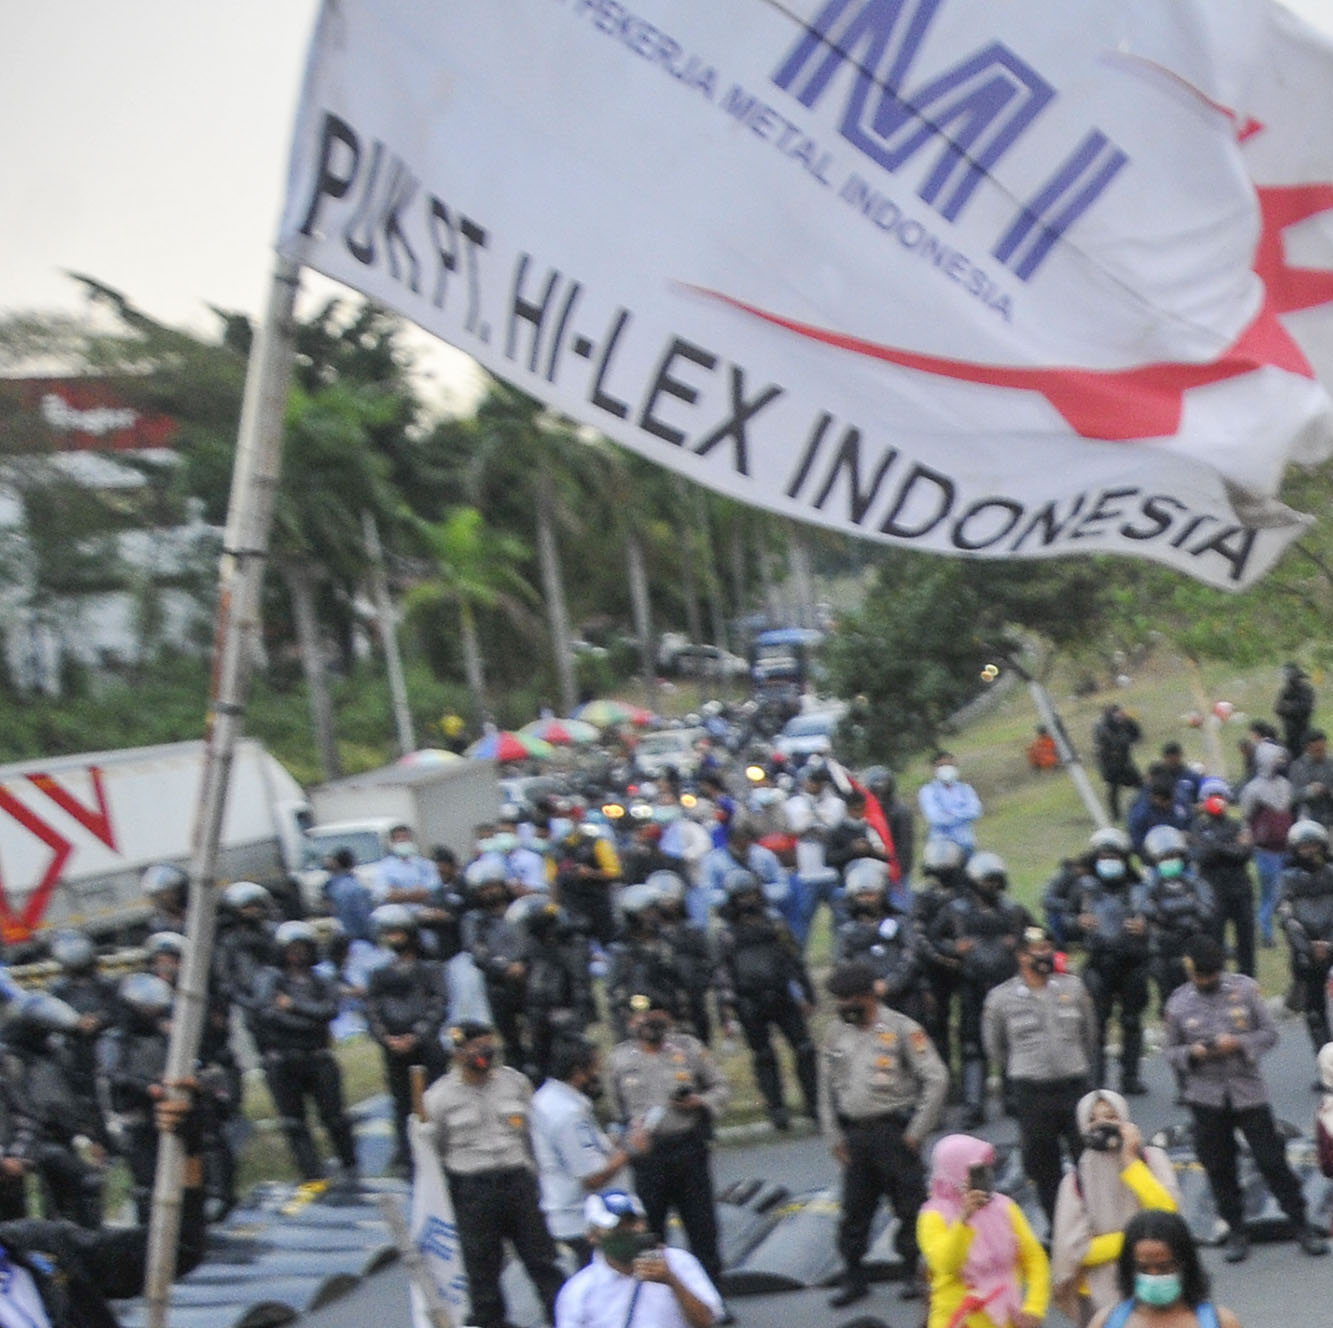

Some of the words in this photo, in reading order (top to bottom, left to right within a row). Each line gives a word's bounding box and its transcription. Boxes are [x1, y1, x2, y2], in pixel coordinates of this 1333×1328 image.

[300, 110, 424, 296] PUK
[504, 252, 785, 477] HI-LEX
[784, 408, 1260, 582] INDONESIA
[719, 83, 832, 187] METAL
[837, 172, 1014, 323] INDONESIA
